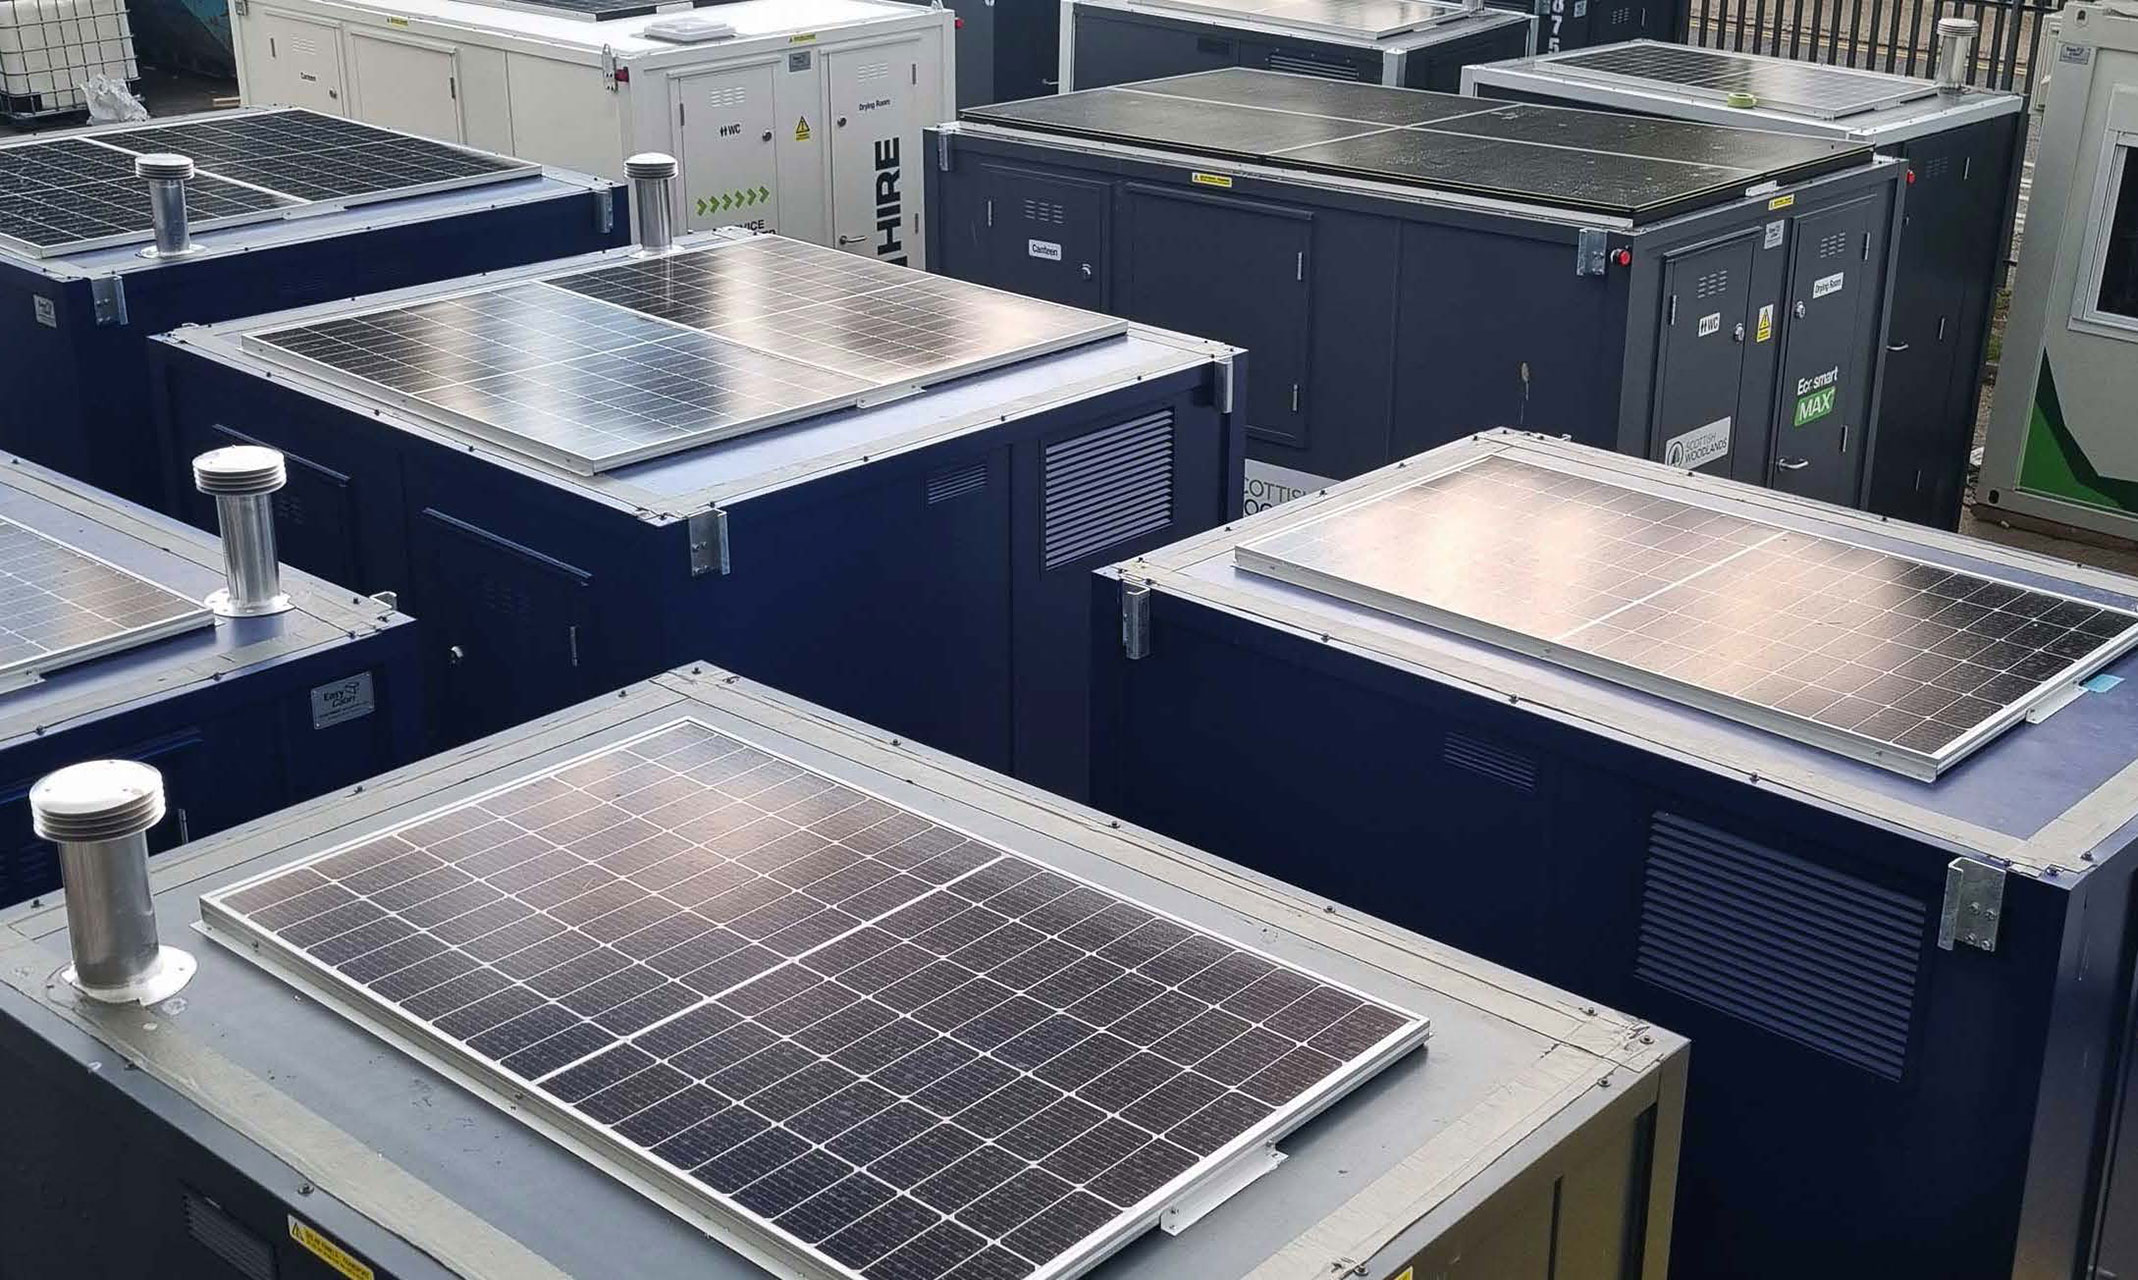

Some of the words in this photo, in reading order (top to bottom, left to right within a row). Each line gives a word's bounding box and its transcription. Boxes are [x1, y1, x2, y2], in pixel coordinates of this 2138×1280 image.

[728, 123, 741, 136] WC
[875, 137, 901, 256] HIRE
[1707, 315, 1719, 331] WC
[1799, 389, 1832, 421] MAX
